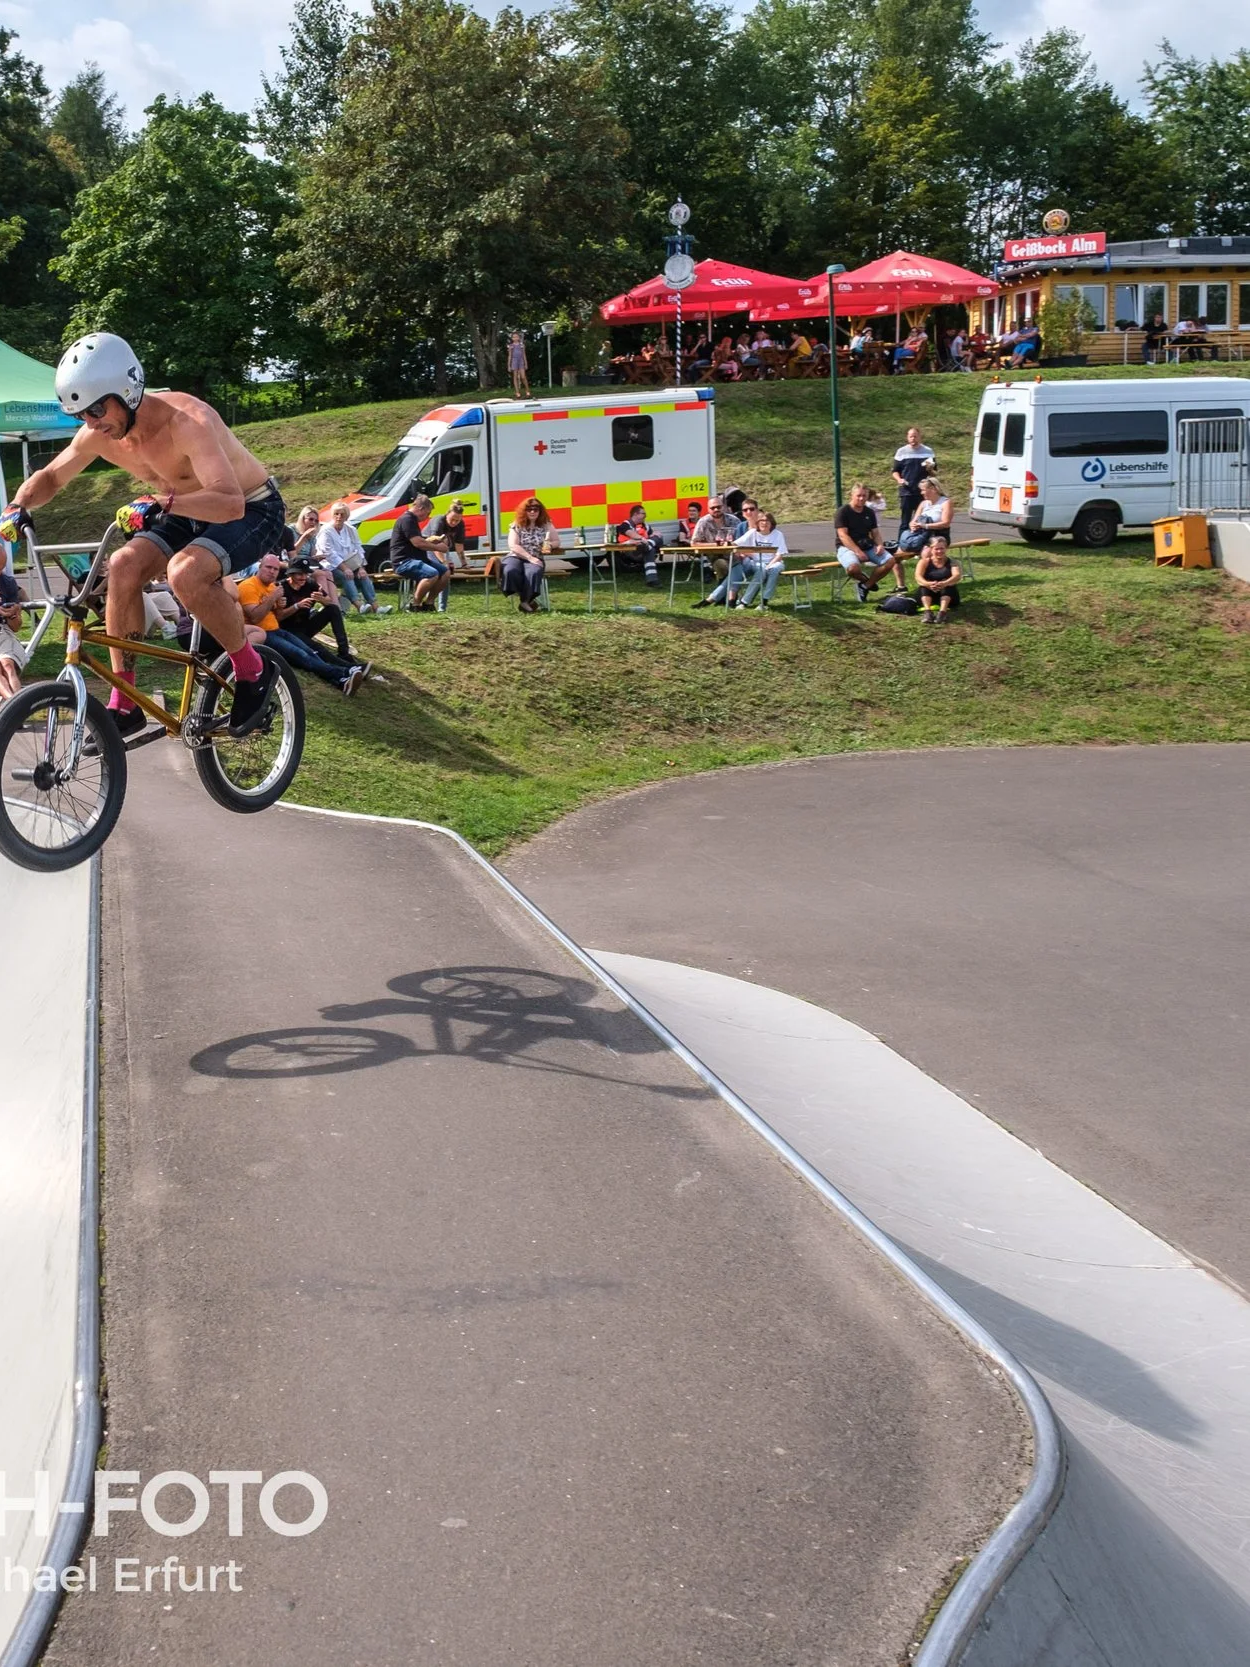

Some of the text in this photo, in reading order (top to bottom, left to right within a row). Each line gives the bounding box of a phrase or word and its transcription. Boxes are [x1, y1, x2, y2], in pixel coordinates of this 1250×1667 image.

[1011, 238, 1097, 257] Geißbock Alm
[4, 403, 60, 413] Lebenshilfe
[1109, 461, 1169, 472] Lebenshilfe
[690, 482, 705, 491] 112
